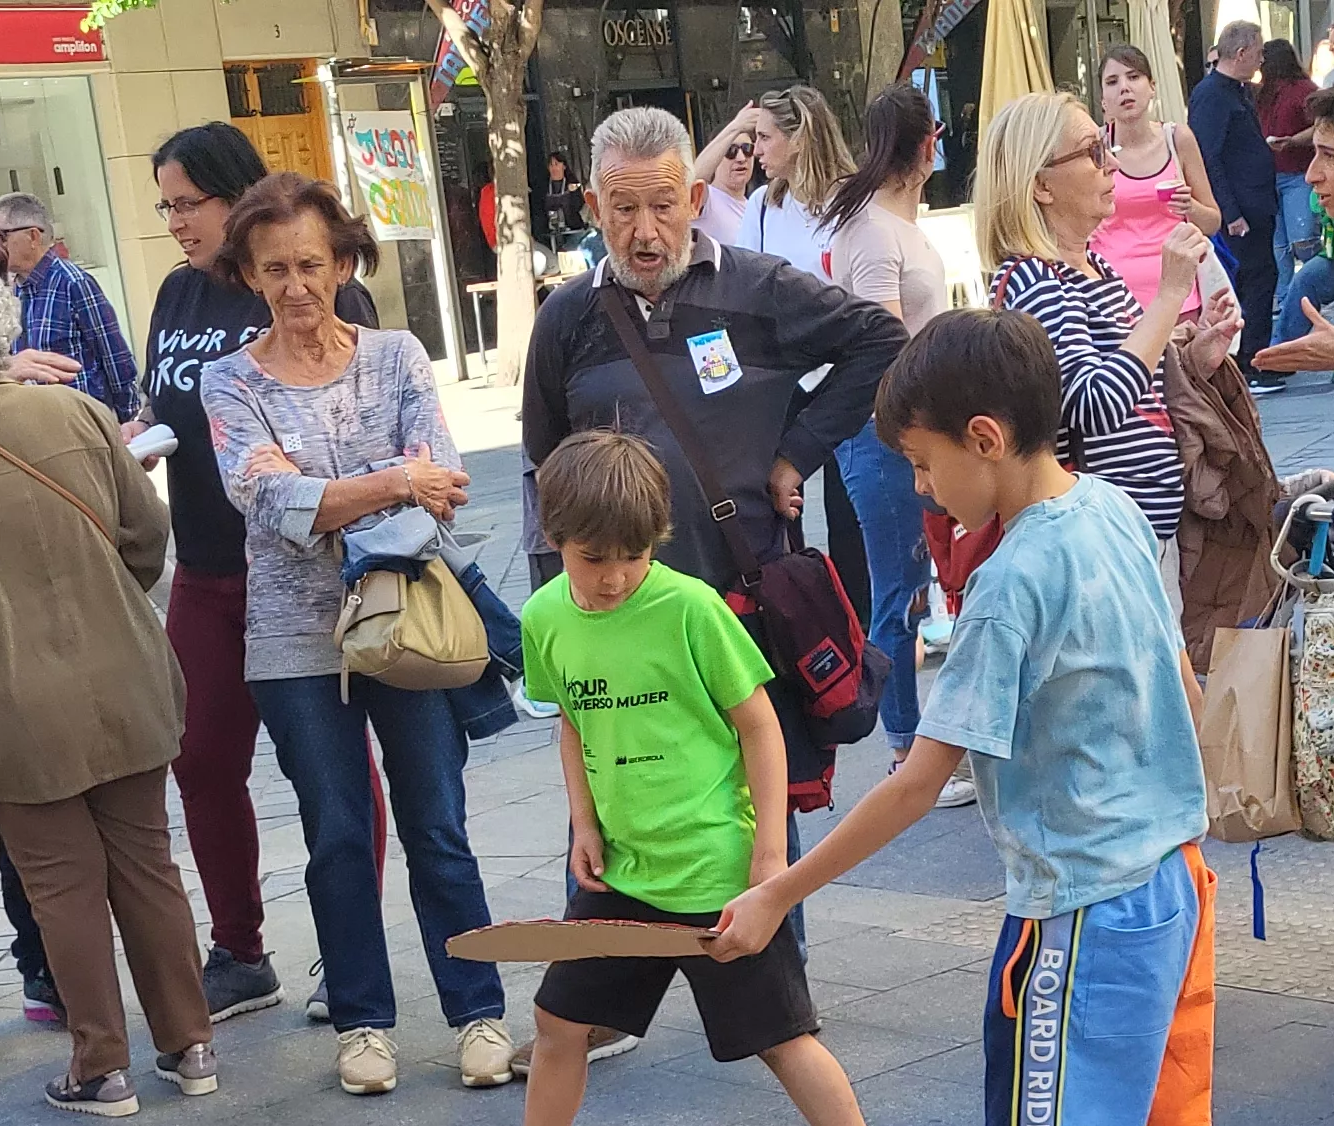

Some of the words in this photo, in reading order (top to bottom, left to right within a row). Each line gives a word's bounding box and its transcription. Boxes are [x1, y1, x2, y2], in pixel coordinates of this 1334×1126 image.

[273, 24, 280, 39] 3
[604, 19, 673, 46] OSCENSE
[54, 40, 98, 55] amplifon
[616, 690, 669, 709] MUJER
[1029, 948, 1065, 1063] BOARD
